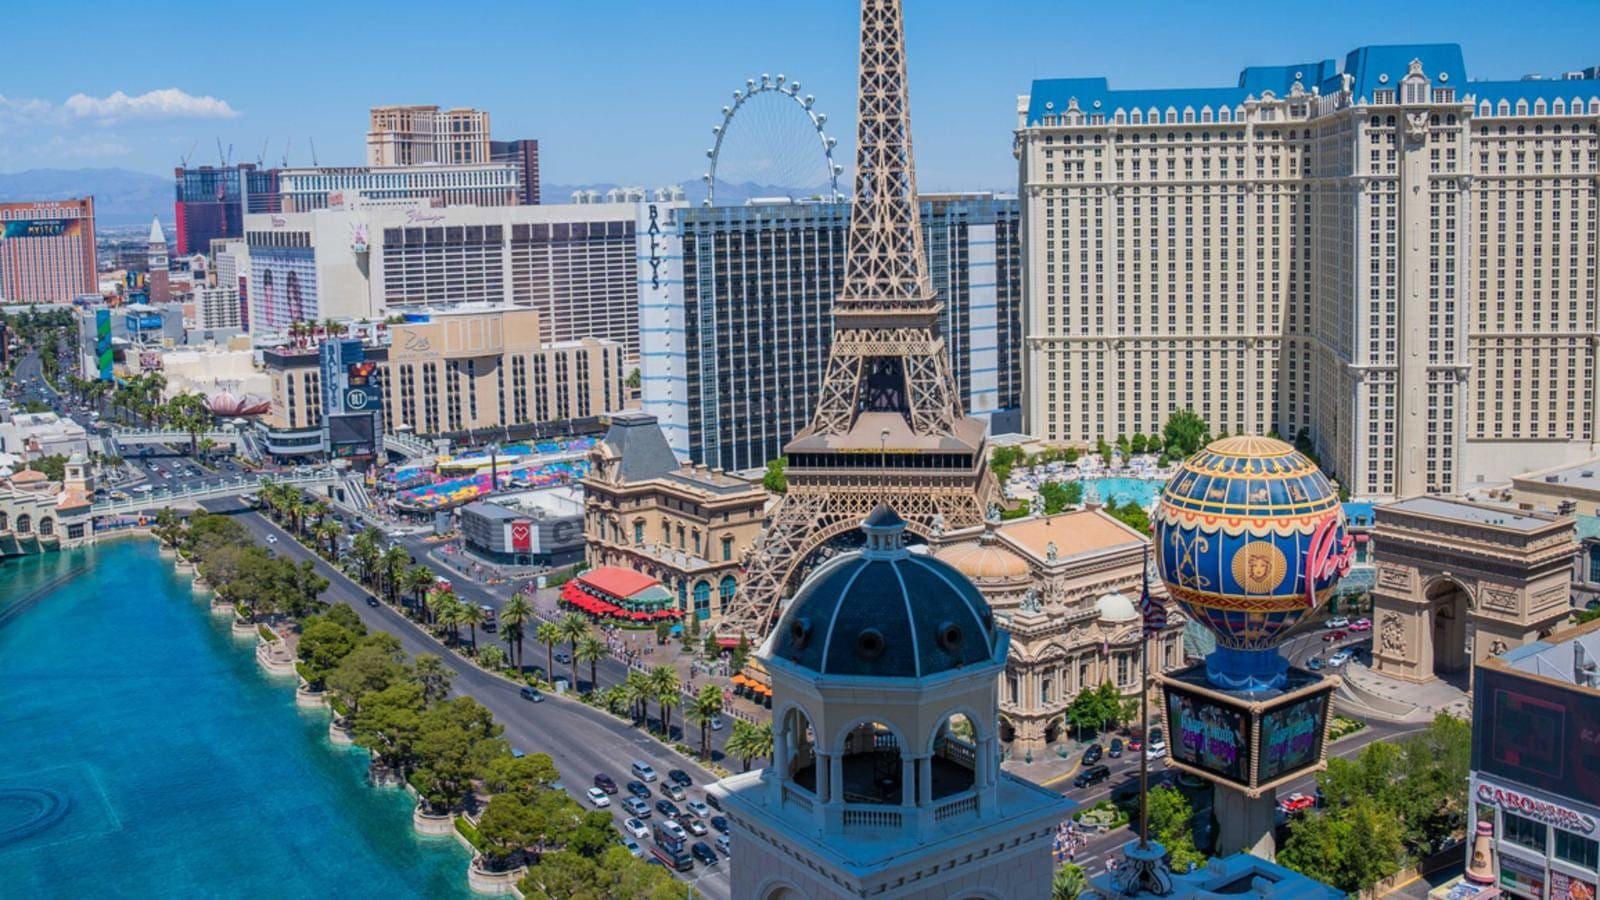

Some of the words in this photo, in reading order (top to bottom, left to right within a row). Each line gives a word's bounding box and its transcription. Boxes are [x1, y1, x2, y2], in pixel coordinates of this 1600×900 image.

[319, 167, 371, 175] VENETIAN
[351, 392, 363, 405] BLT
[1478, 784, 1536, 814] CABO
